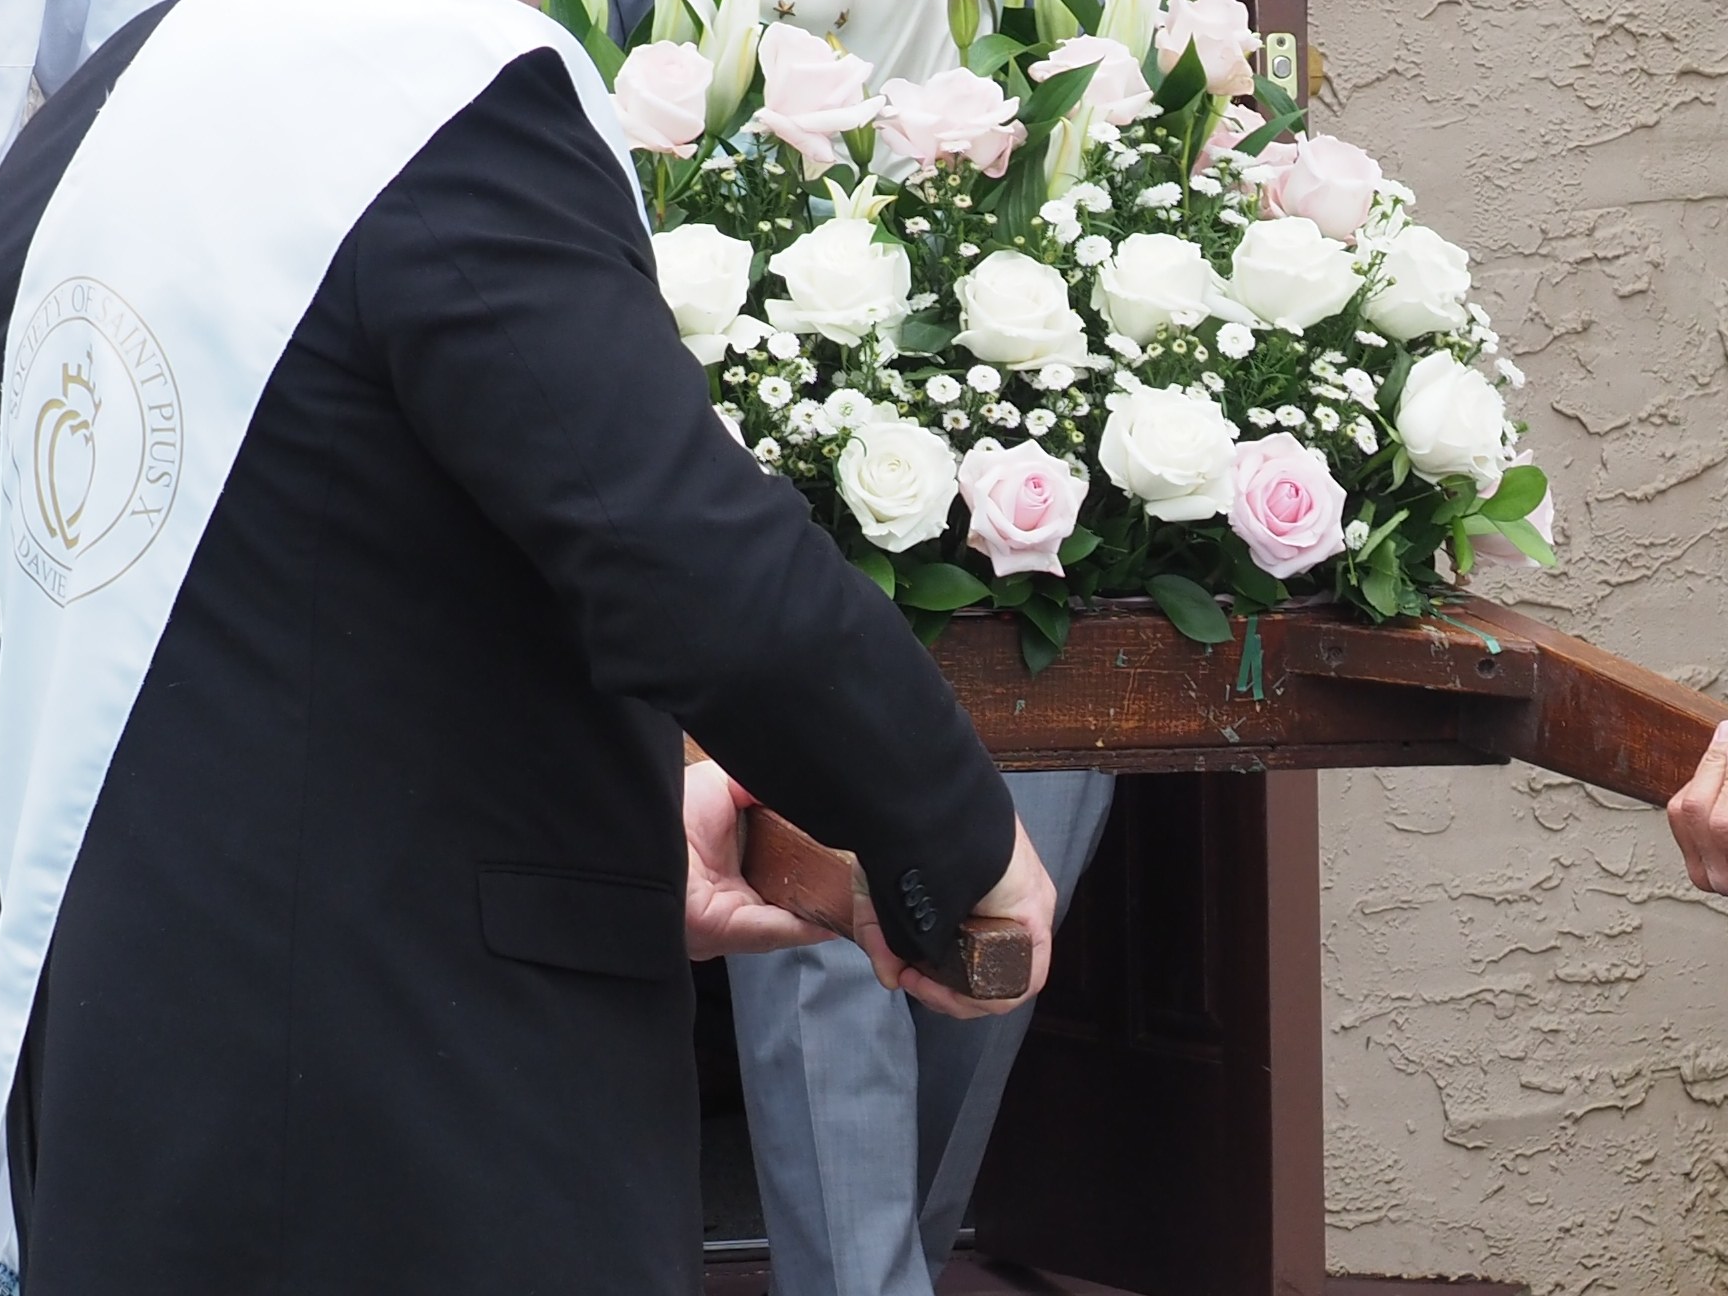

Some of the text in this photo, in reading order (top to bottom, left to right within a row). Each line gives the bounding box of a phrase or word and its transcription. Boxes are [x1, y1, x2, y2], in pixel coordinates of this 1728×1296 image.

[10, 284, 176, 529] SOCIETY OF SAINT PIUS X
[17, 533, 68, 599] DAVIE
